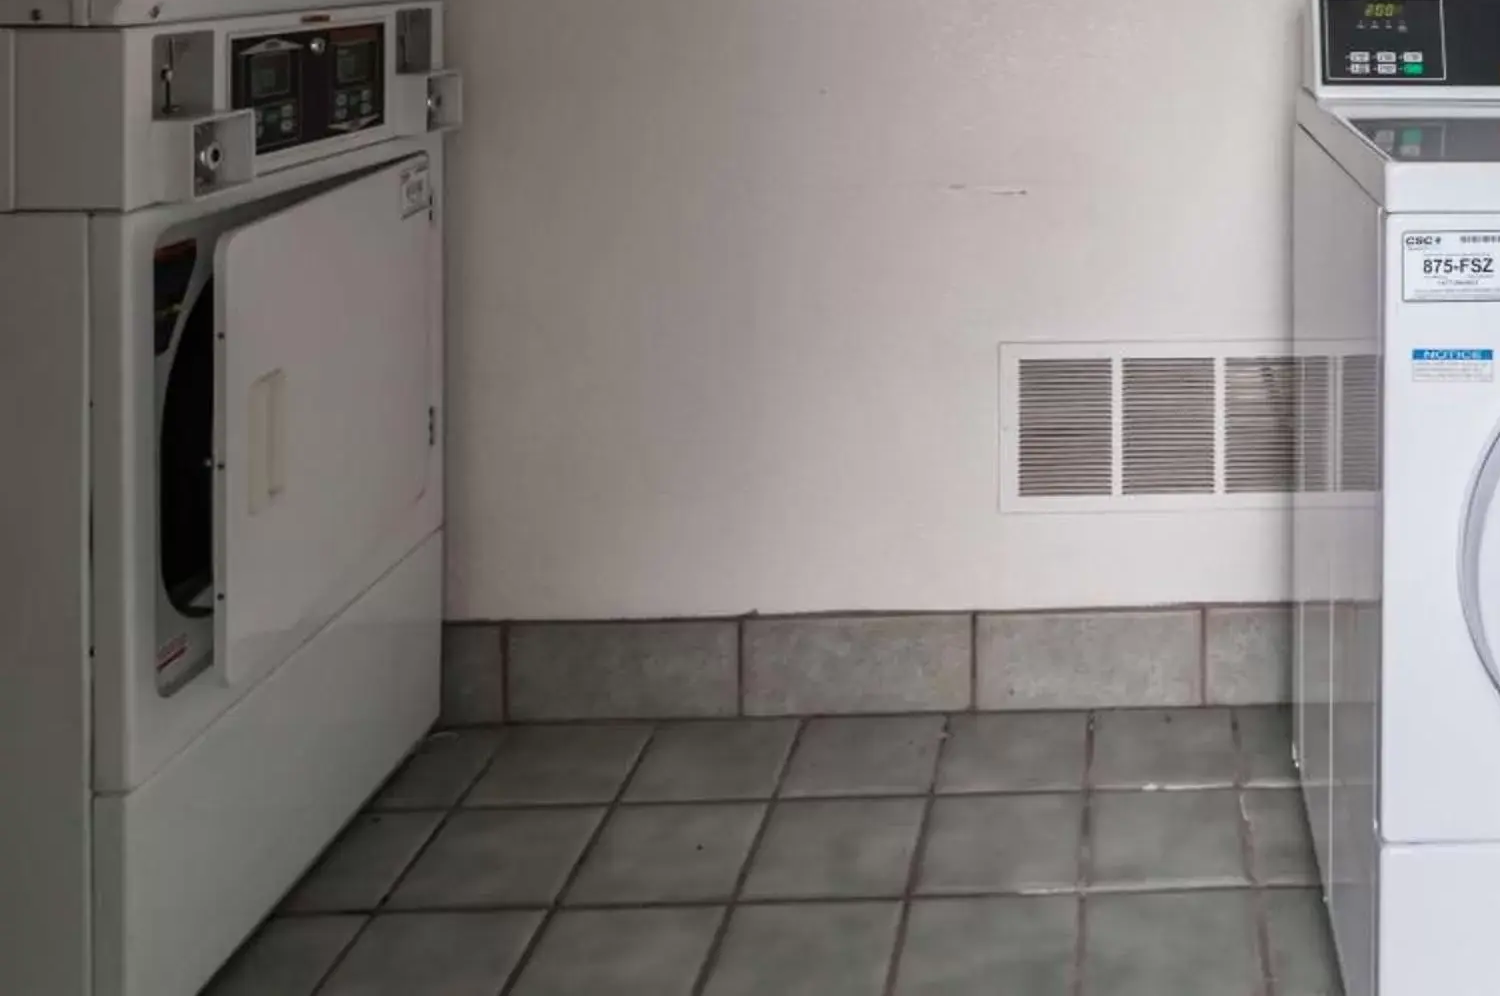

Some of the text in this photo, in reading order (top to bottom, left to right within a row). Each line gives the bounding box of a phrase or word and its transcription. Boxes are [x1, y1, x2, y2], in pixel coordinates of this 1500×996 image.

[1406, 235, 1433, 245] CSC
[1423, 257, 1495, 274] 875-FSZ
[1423, 349, 1482, 359] NOTICE
